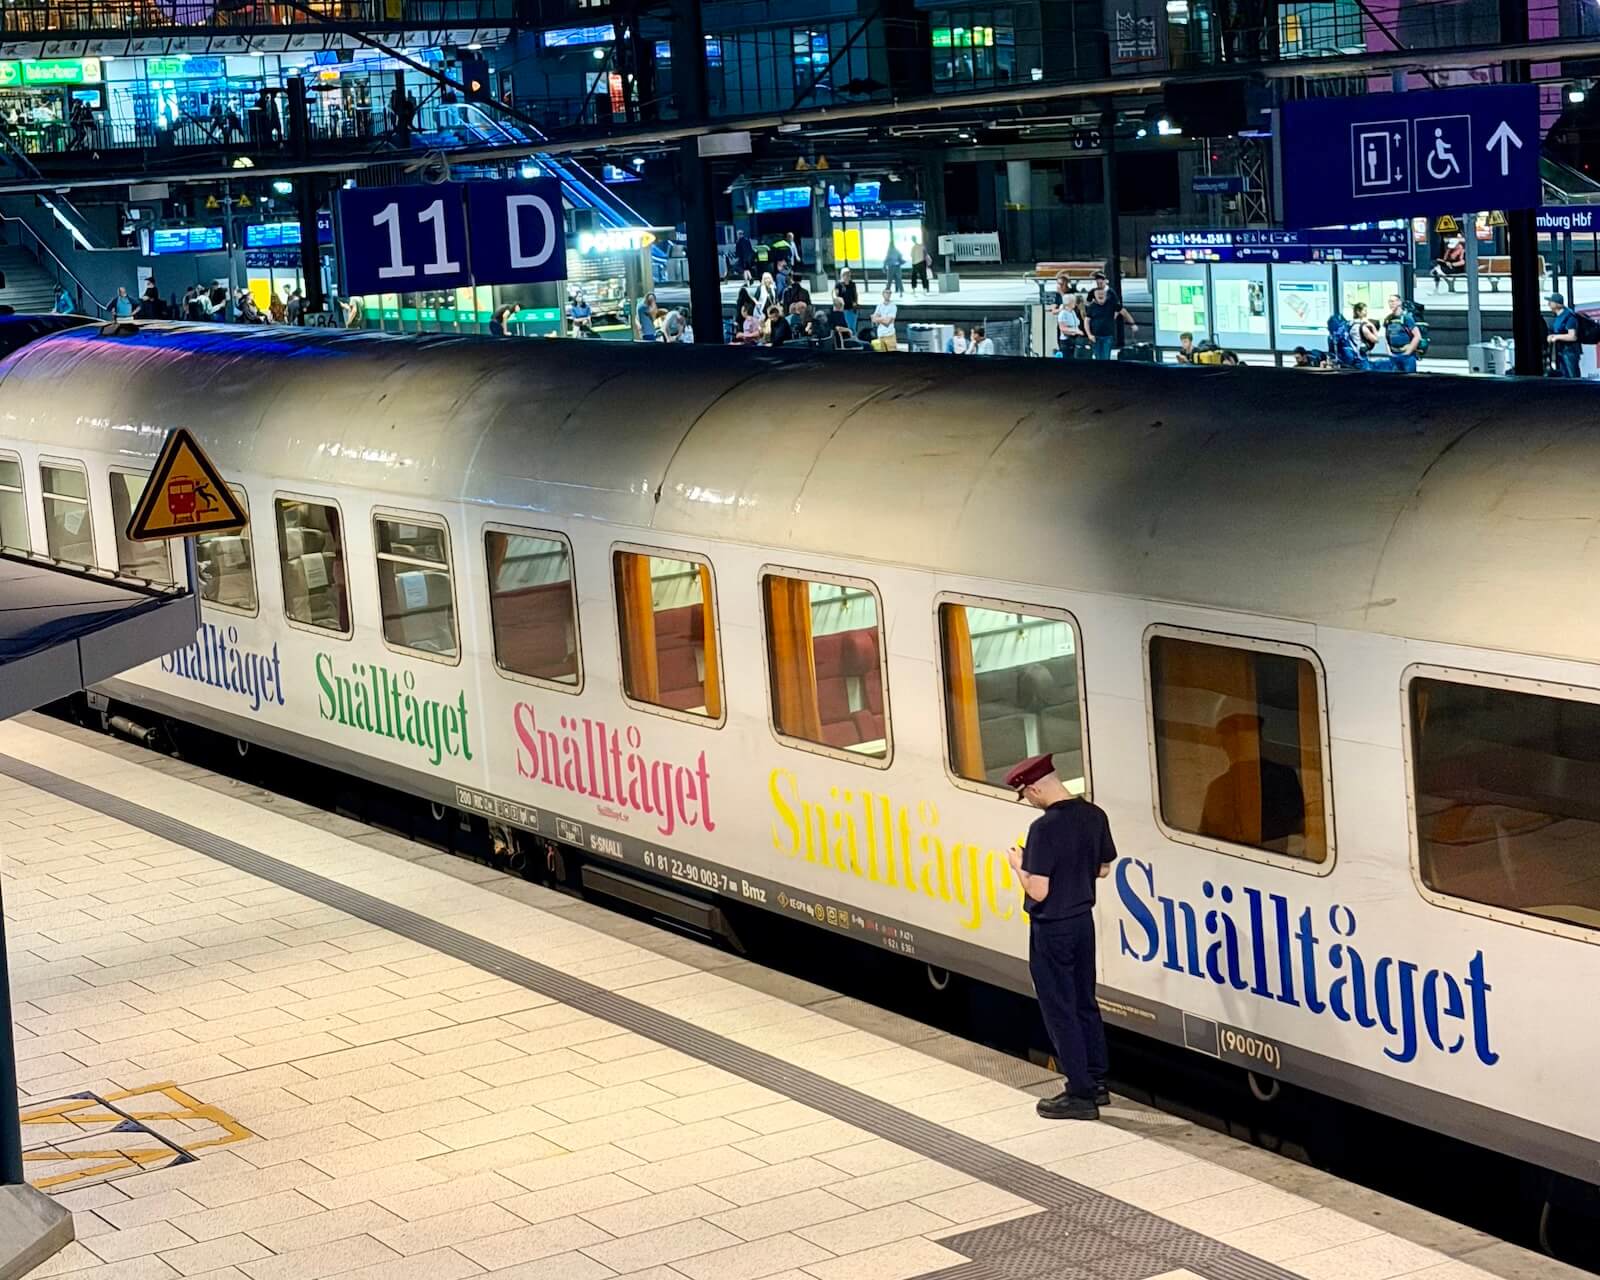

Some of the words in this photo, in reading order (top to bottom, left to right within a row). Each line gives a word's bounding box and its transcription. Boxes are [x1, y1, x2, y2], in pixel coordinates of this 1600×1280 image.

[373, 199, 460, 279] 11
[506, 194, 556, 269] D
[1536, 212, 1570, 229] mburg
[1572, 212, 1592, 227] Hbf
[315, 652, 473, 766] Snälltåget
[513, 702, 716, 836] Snälltåget
[644, 850, 655, 868] 61
[657, 854, 669, 872] 81
[671, 859, 699, 881] 22-90
[700, 868, 728, 891] 003-7
[741, 879, 767, 903] Bmz
[1115, 857, 1500, 1066] Snälltåget
[1220, 1029, 1281, 1070] (90070)
